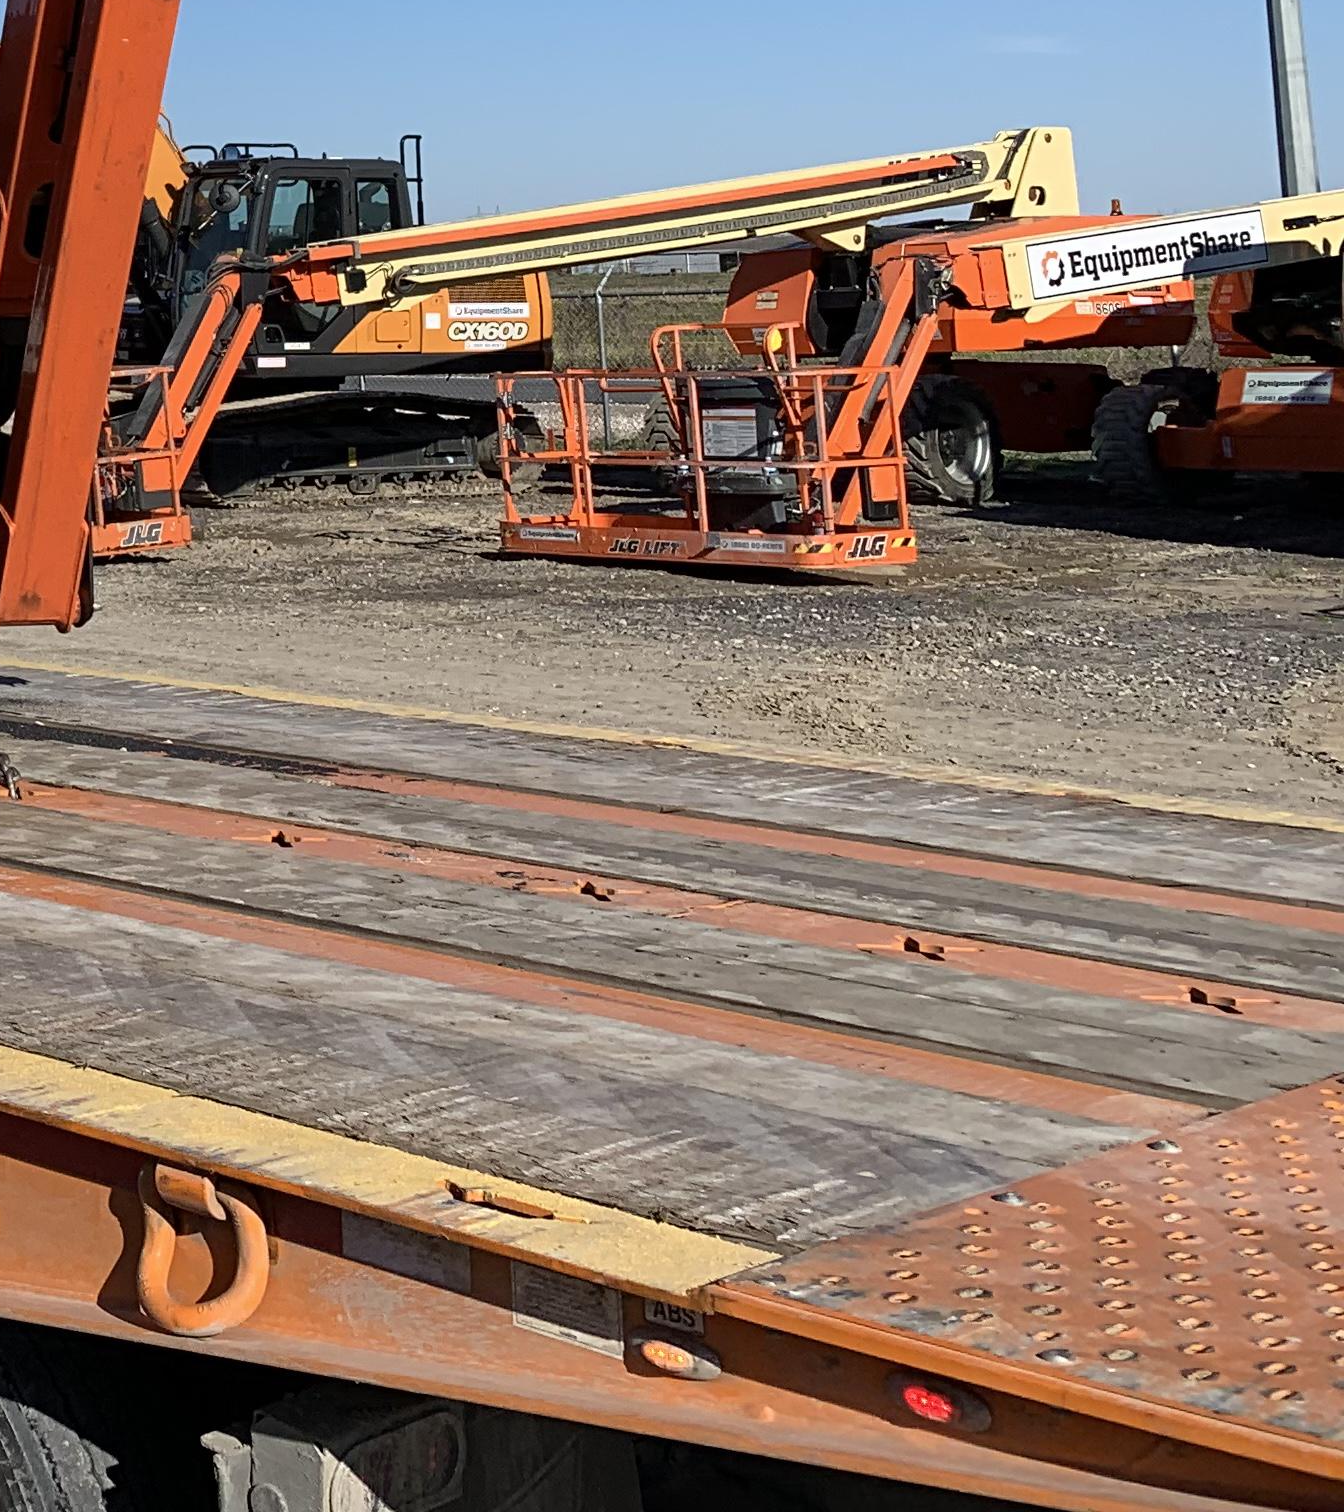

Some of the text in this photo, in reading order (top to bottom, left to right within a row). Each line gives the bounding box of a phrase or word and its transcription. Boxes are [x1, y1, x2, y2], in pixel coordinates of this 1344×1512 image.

[1068, 229, 1253, 281] EquipmentShare
[447, 320, 530, 342] CX160D
[120, 520, 165, 548] JLG
[608, 539, 681, 556] JLG LIFT
[846, 534, 888, 560] JLG
[653, 1300, 696, 1328] ABS
